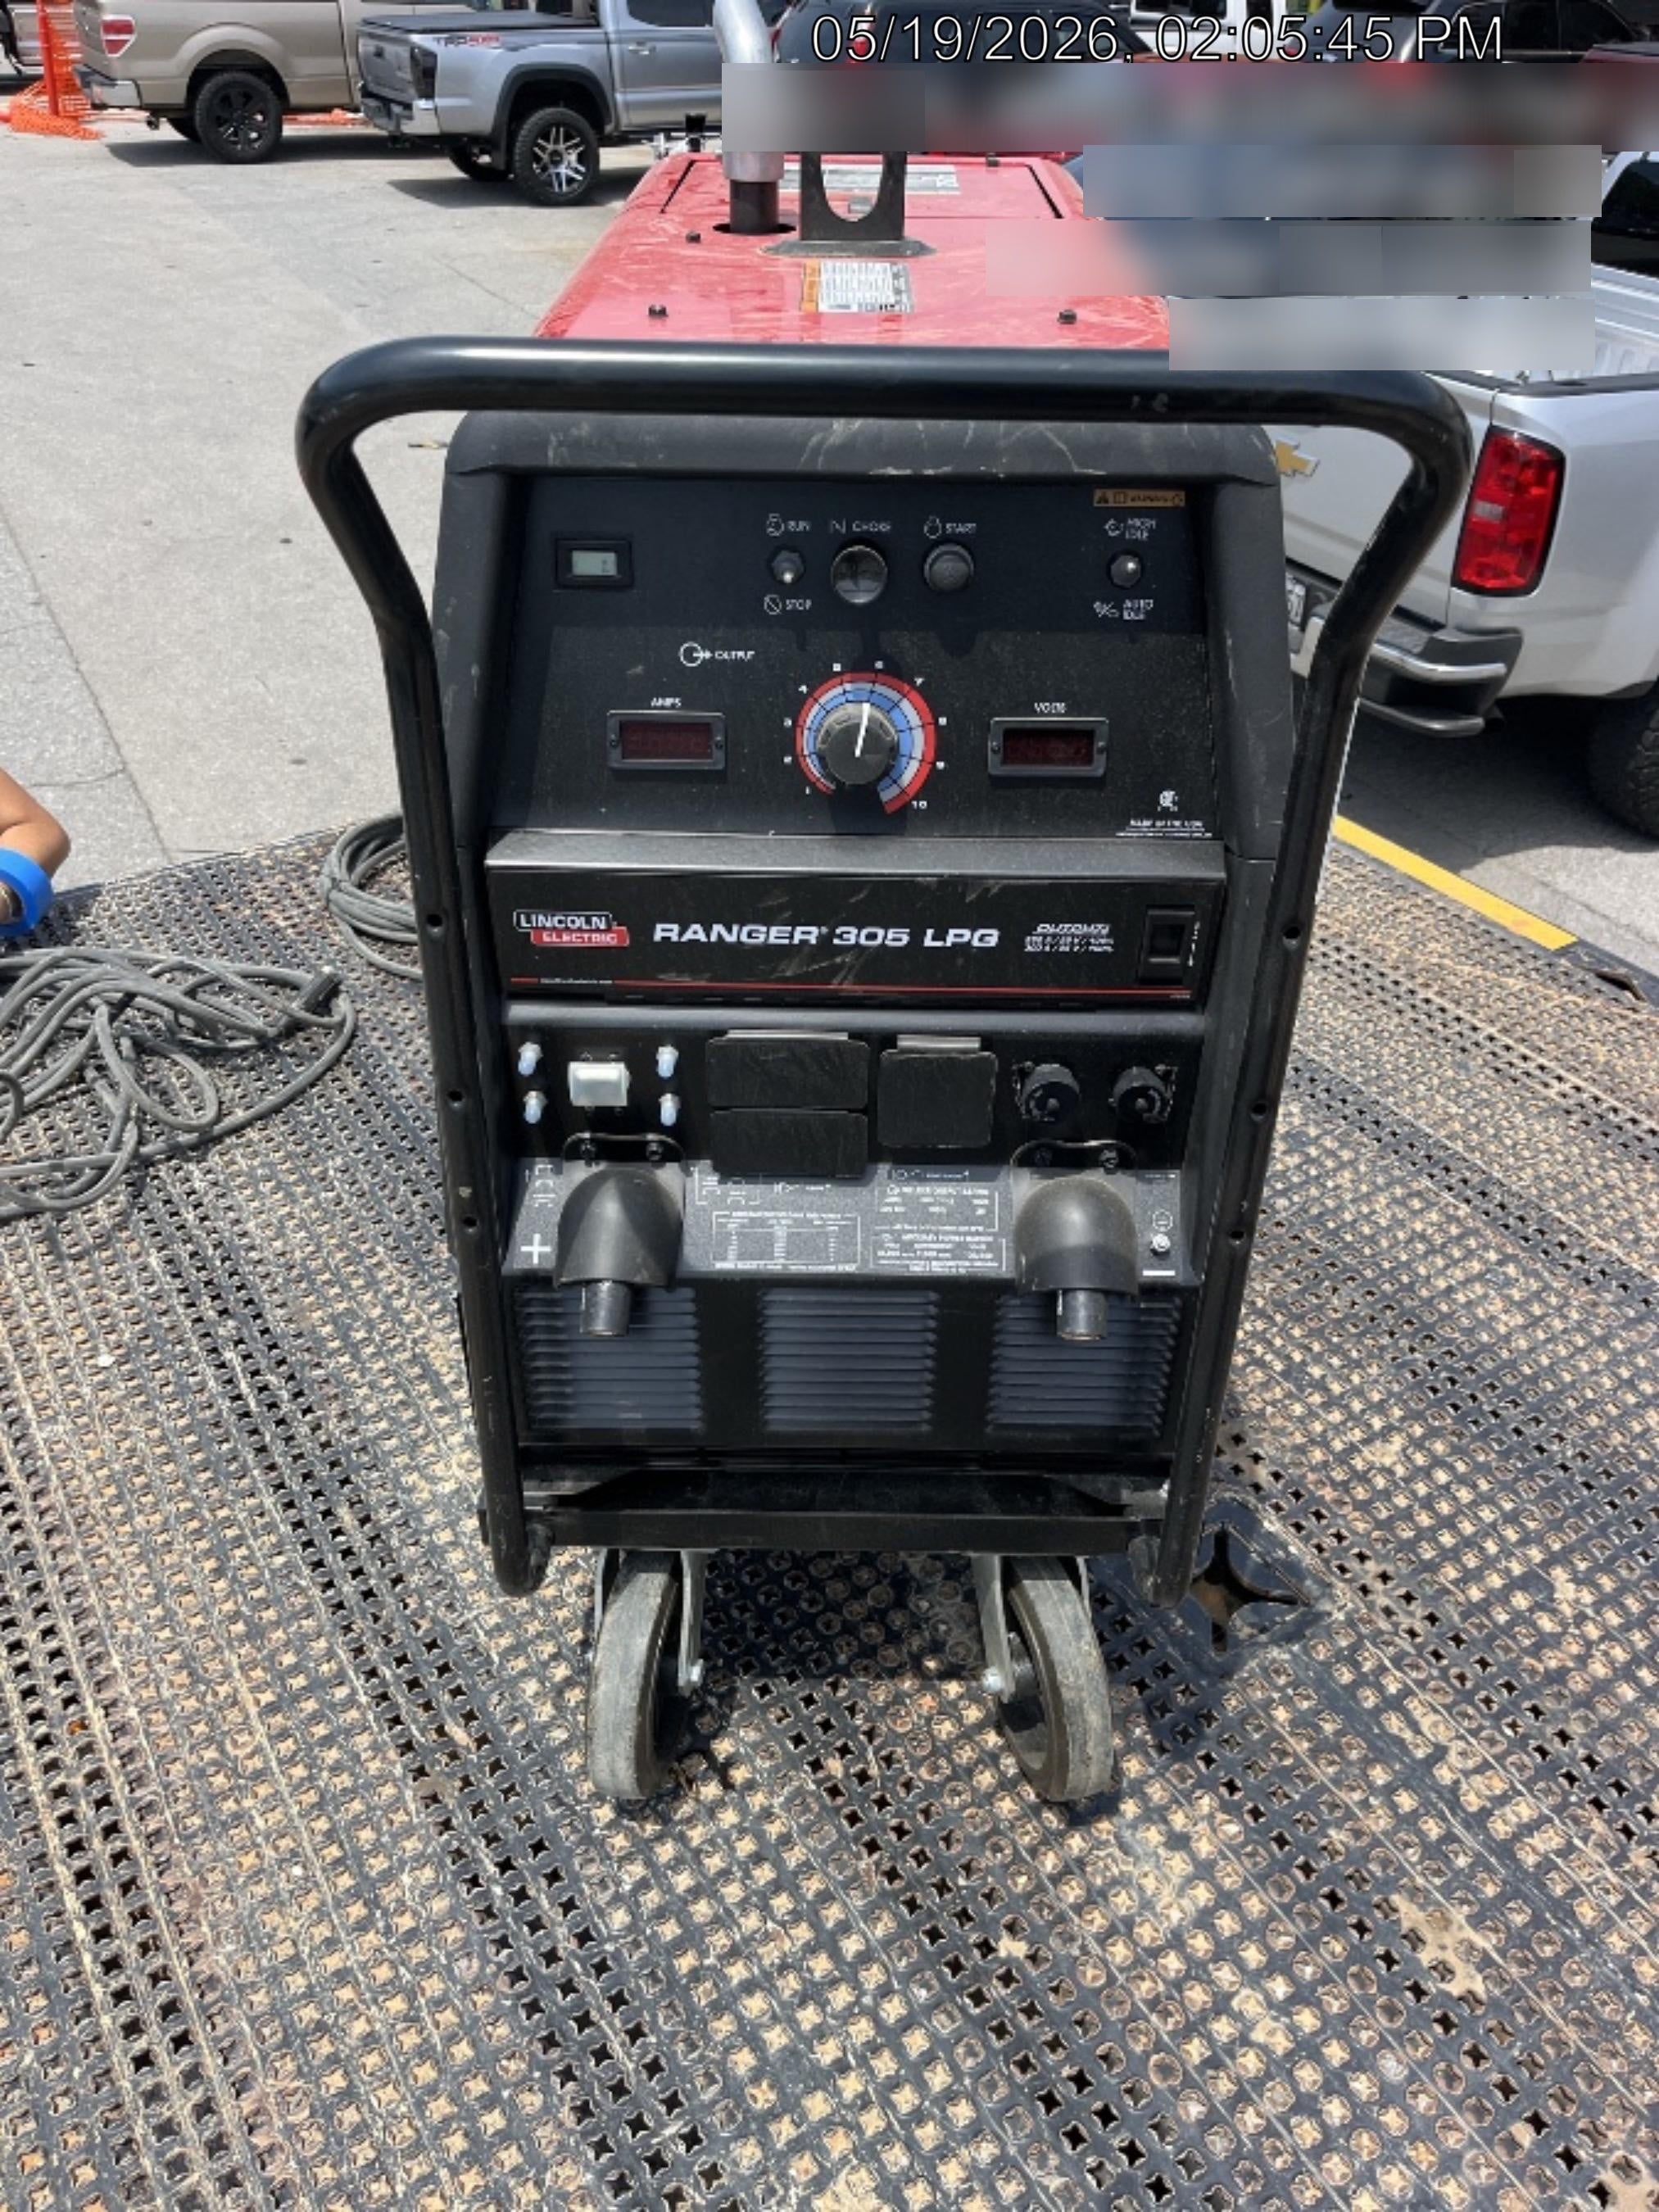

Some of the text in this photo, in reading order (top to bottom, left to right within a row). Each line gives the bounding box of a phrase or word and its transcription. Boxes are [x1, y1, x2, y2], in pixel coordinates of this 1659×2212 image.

[945, 522, 977, 534] START
[786, 598, 813, 610] STOP
[650, 697, 682, 709] AMPS
[1034, 701, 1067, 714] VOLTS
[911, 800, 927, 809] 10
[519, 913, 608, 930] LINCOLN
[542, 931, 618, 945] ELECTRIC
[832, 927, 911, 947] 305
[923, 928, 1000, 949] LPG
